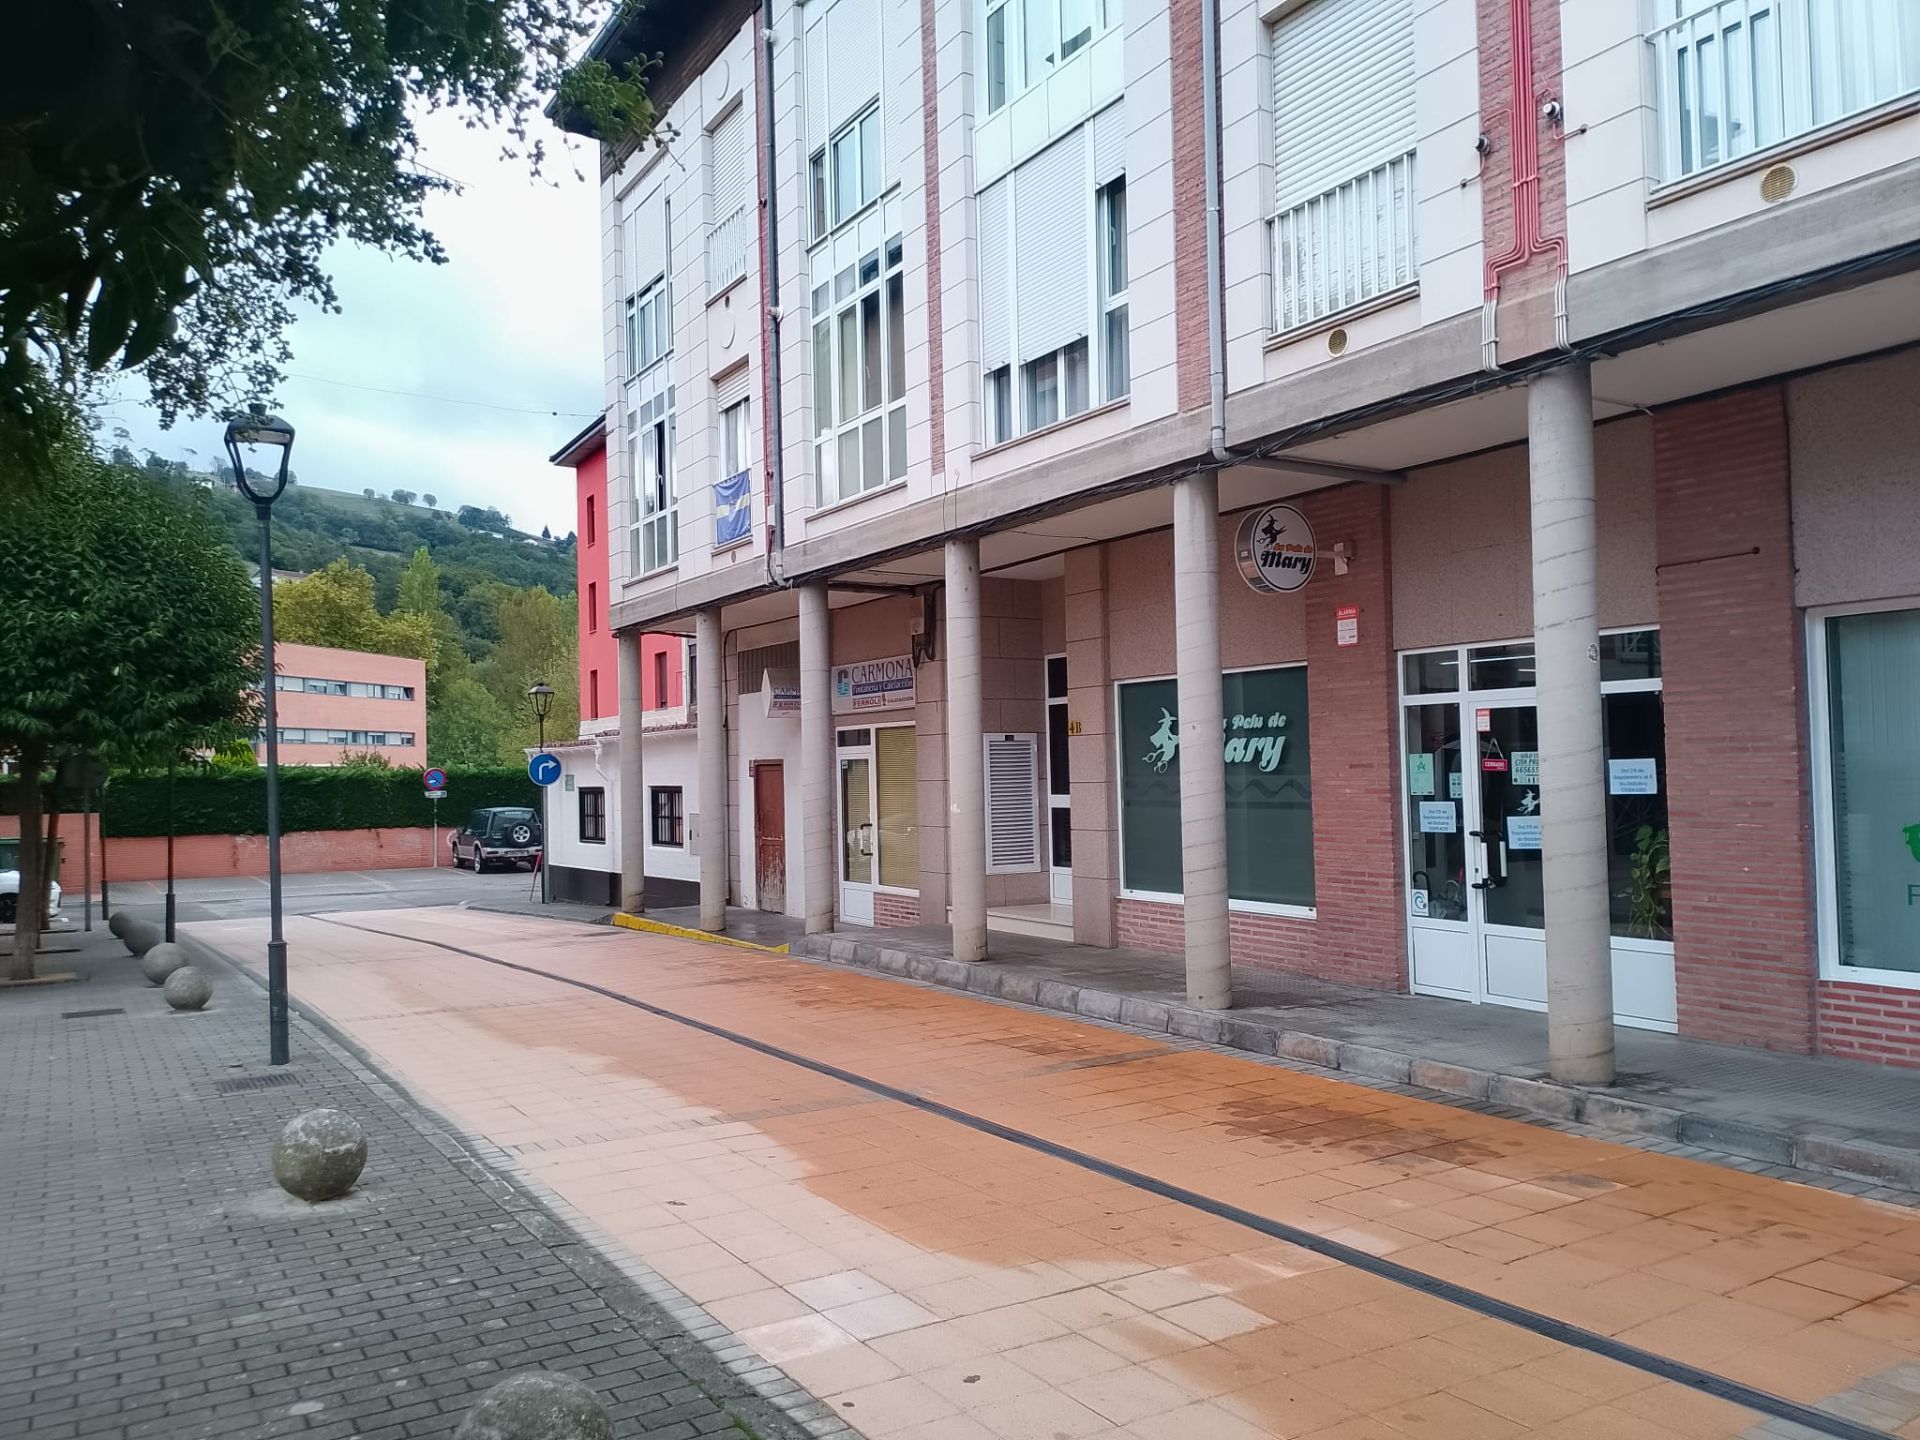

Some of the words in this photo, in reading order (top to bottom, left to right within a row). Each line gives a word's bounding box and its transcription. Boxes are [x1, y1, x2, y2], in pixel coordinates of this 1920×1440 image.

[1261, 550, 1312, 574] Mary
[852, 658, 913, 684] CARMONA
[1232, 714, 1263, 729] Pelu
[1268, 712, 1287, 728] de
[1224, 736, 1286, 772] ary
